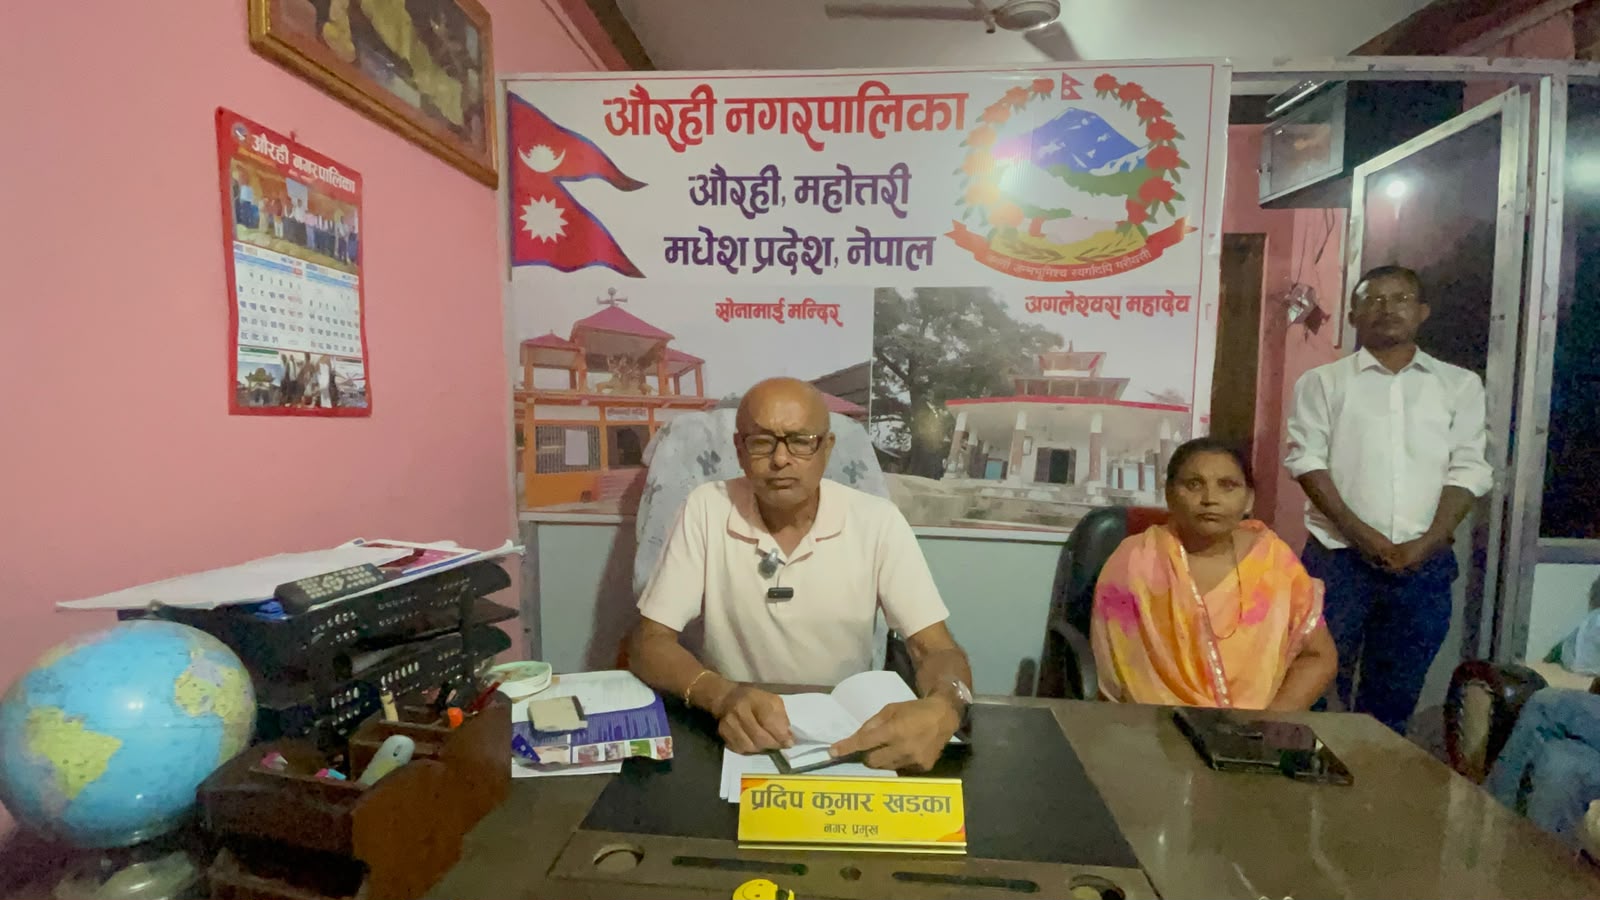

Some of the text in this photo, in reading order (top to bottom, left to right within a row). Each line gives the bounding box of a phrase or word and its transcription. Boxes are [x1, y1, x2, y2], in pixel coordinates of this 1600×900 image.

[603, 80, 969, 153] औरही नगरपालिका
[251, 132, 356, 194] औरही नगरपालिका
[688, 162, 912, 219] औरही, महोत्तरी
[664, 225, 937, 276] मधेश प्रदेश, नेपाल
[715, 297, 843, 327] सोनामाई मन्दिर
[1125, 289, 1192, 317] महादेव
[750, 784, 804, 810] प्रदिप
[811, 791, 875, 816] कुमार
[823, 823, 879, 838] नगर प्रमुख
